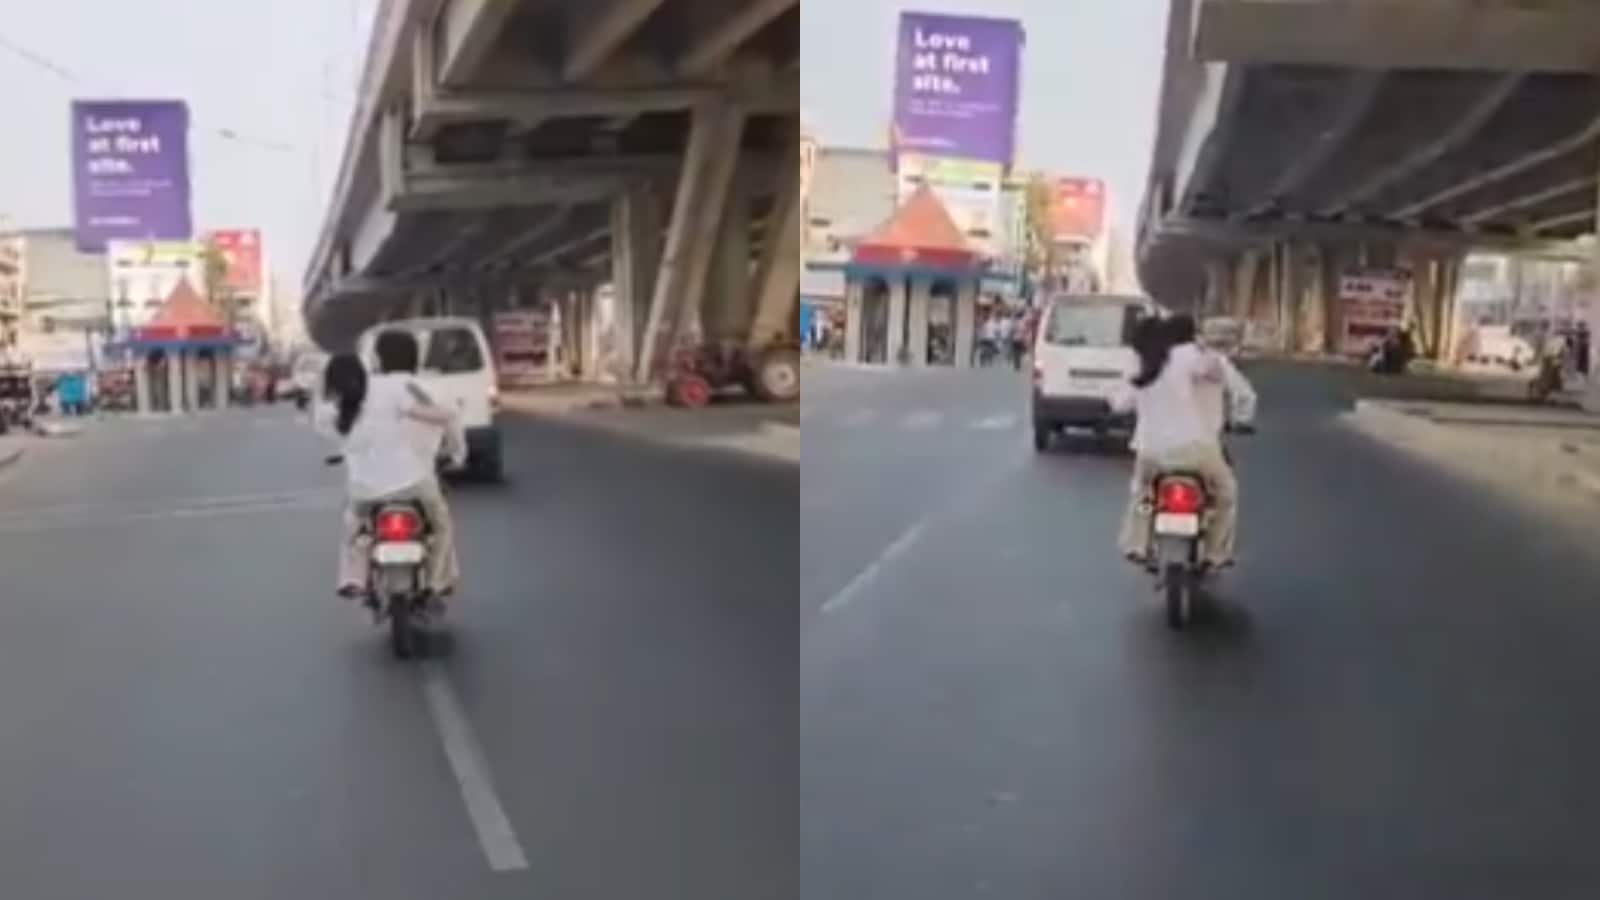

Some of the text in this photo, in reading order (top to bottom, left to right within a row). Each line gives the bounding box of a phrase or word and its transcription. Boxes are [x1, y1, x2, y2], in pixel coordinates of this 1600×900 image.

[914, 26, 971, 50] Love
[912, 52, 991, 74] at first
[912, 73, 961, 94] site.
[85, 116, 142, 133] Love
[88, 135, 161, 153] at first
